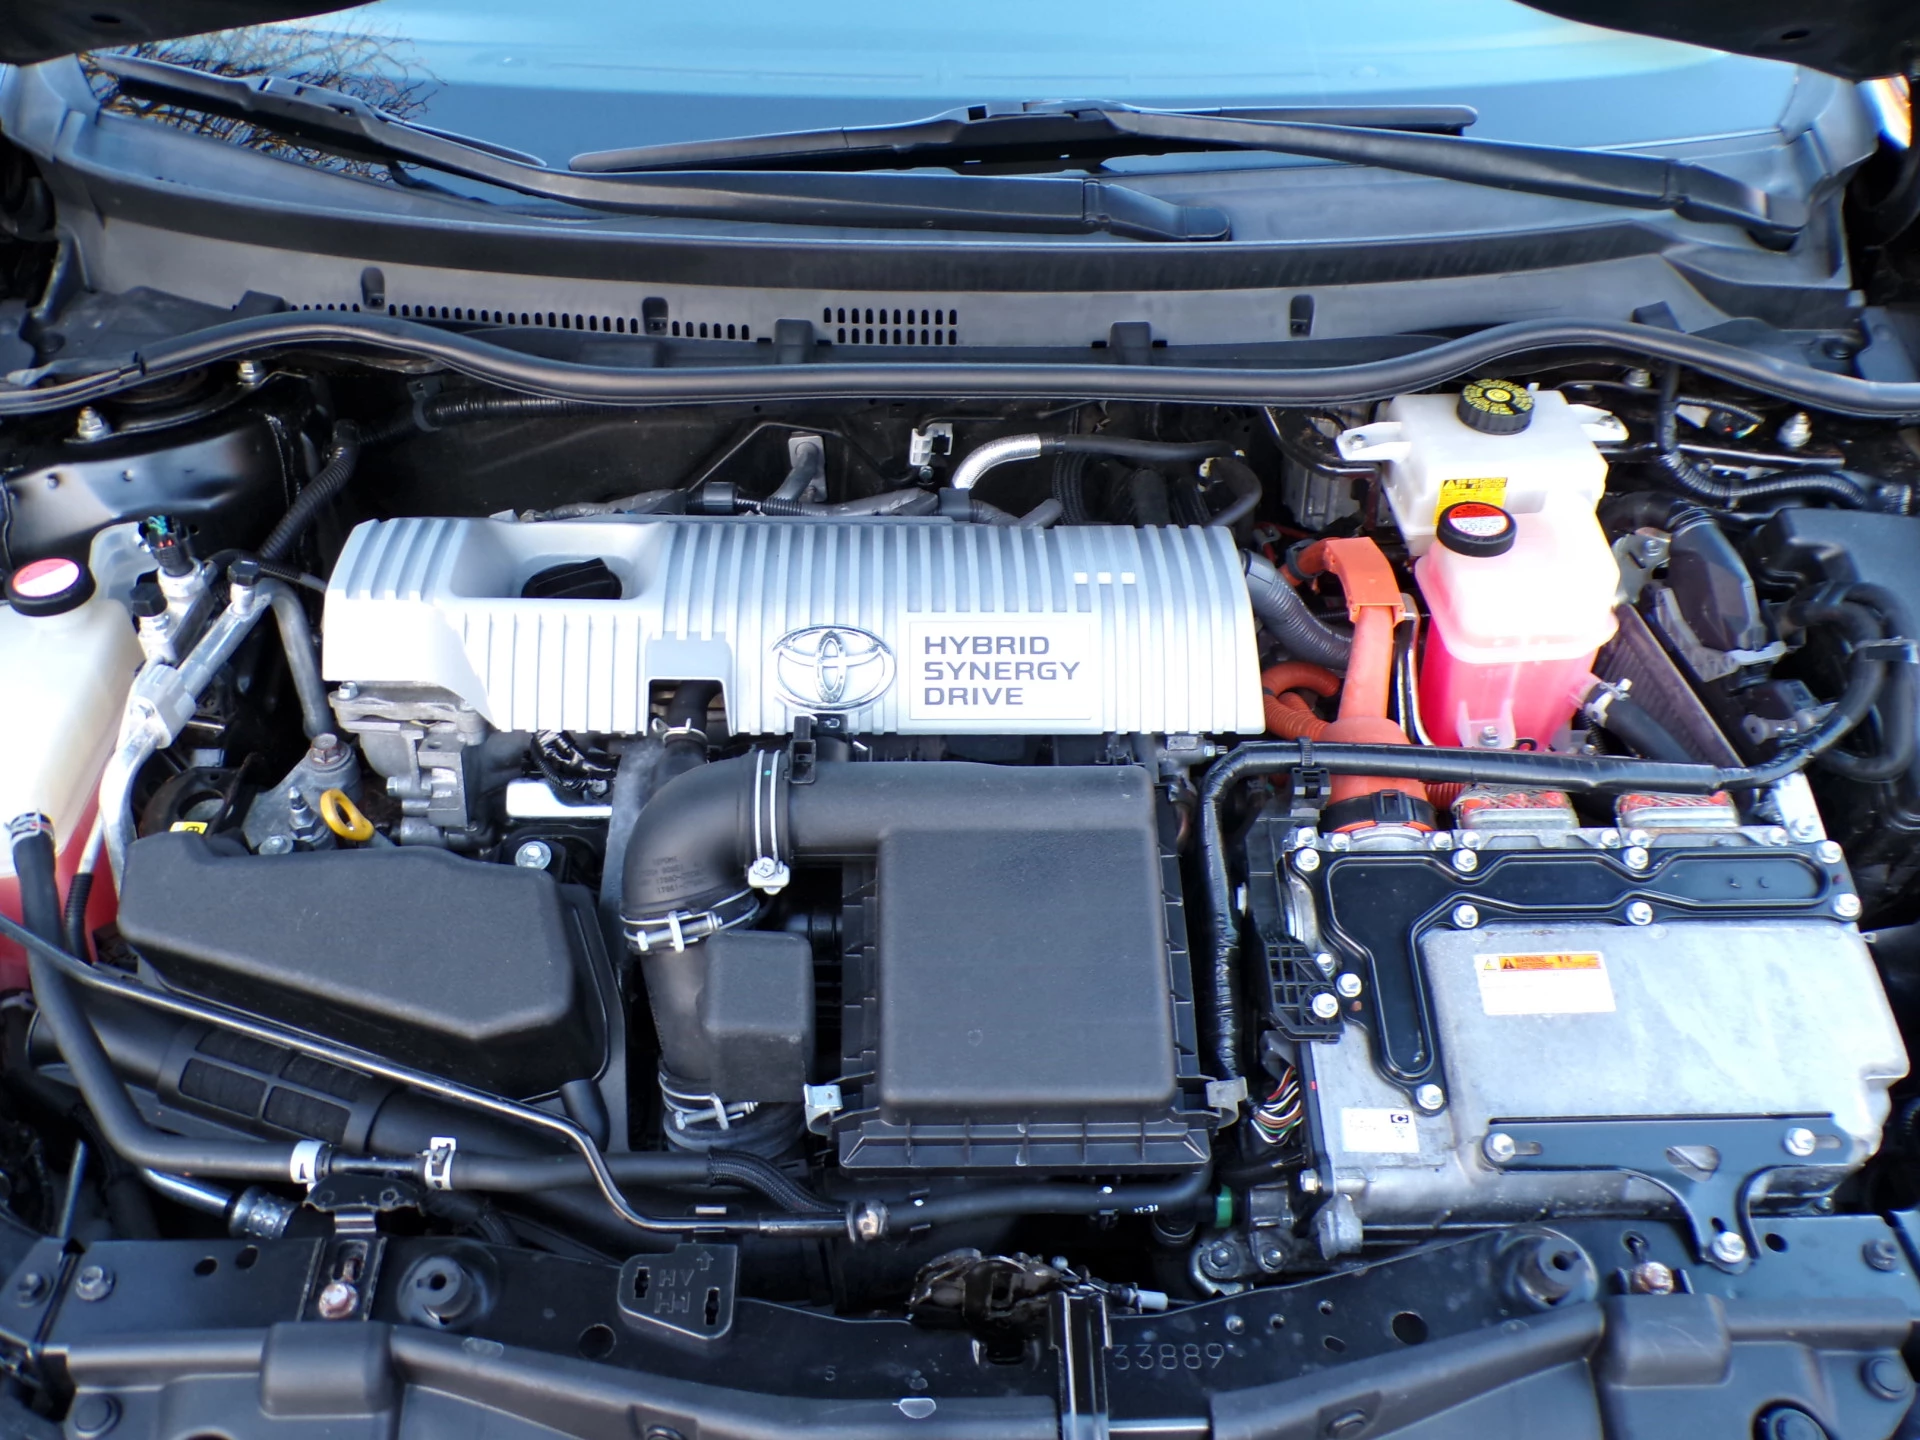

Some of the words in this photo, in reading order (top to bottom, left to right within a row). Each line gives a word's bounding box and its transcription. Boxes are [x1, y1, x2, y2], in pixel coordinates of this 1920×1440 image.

[924, 636, 1050, 654] HYBRID
[924, 661, 1080, 680] SYNERGY
[924, 687, 1024, 705] DRIVE
